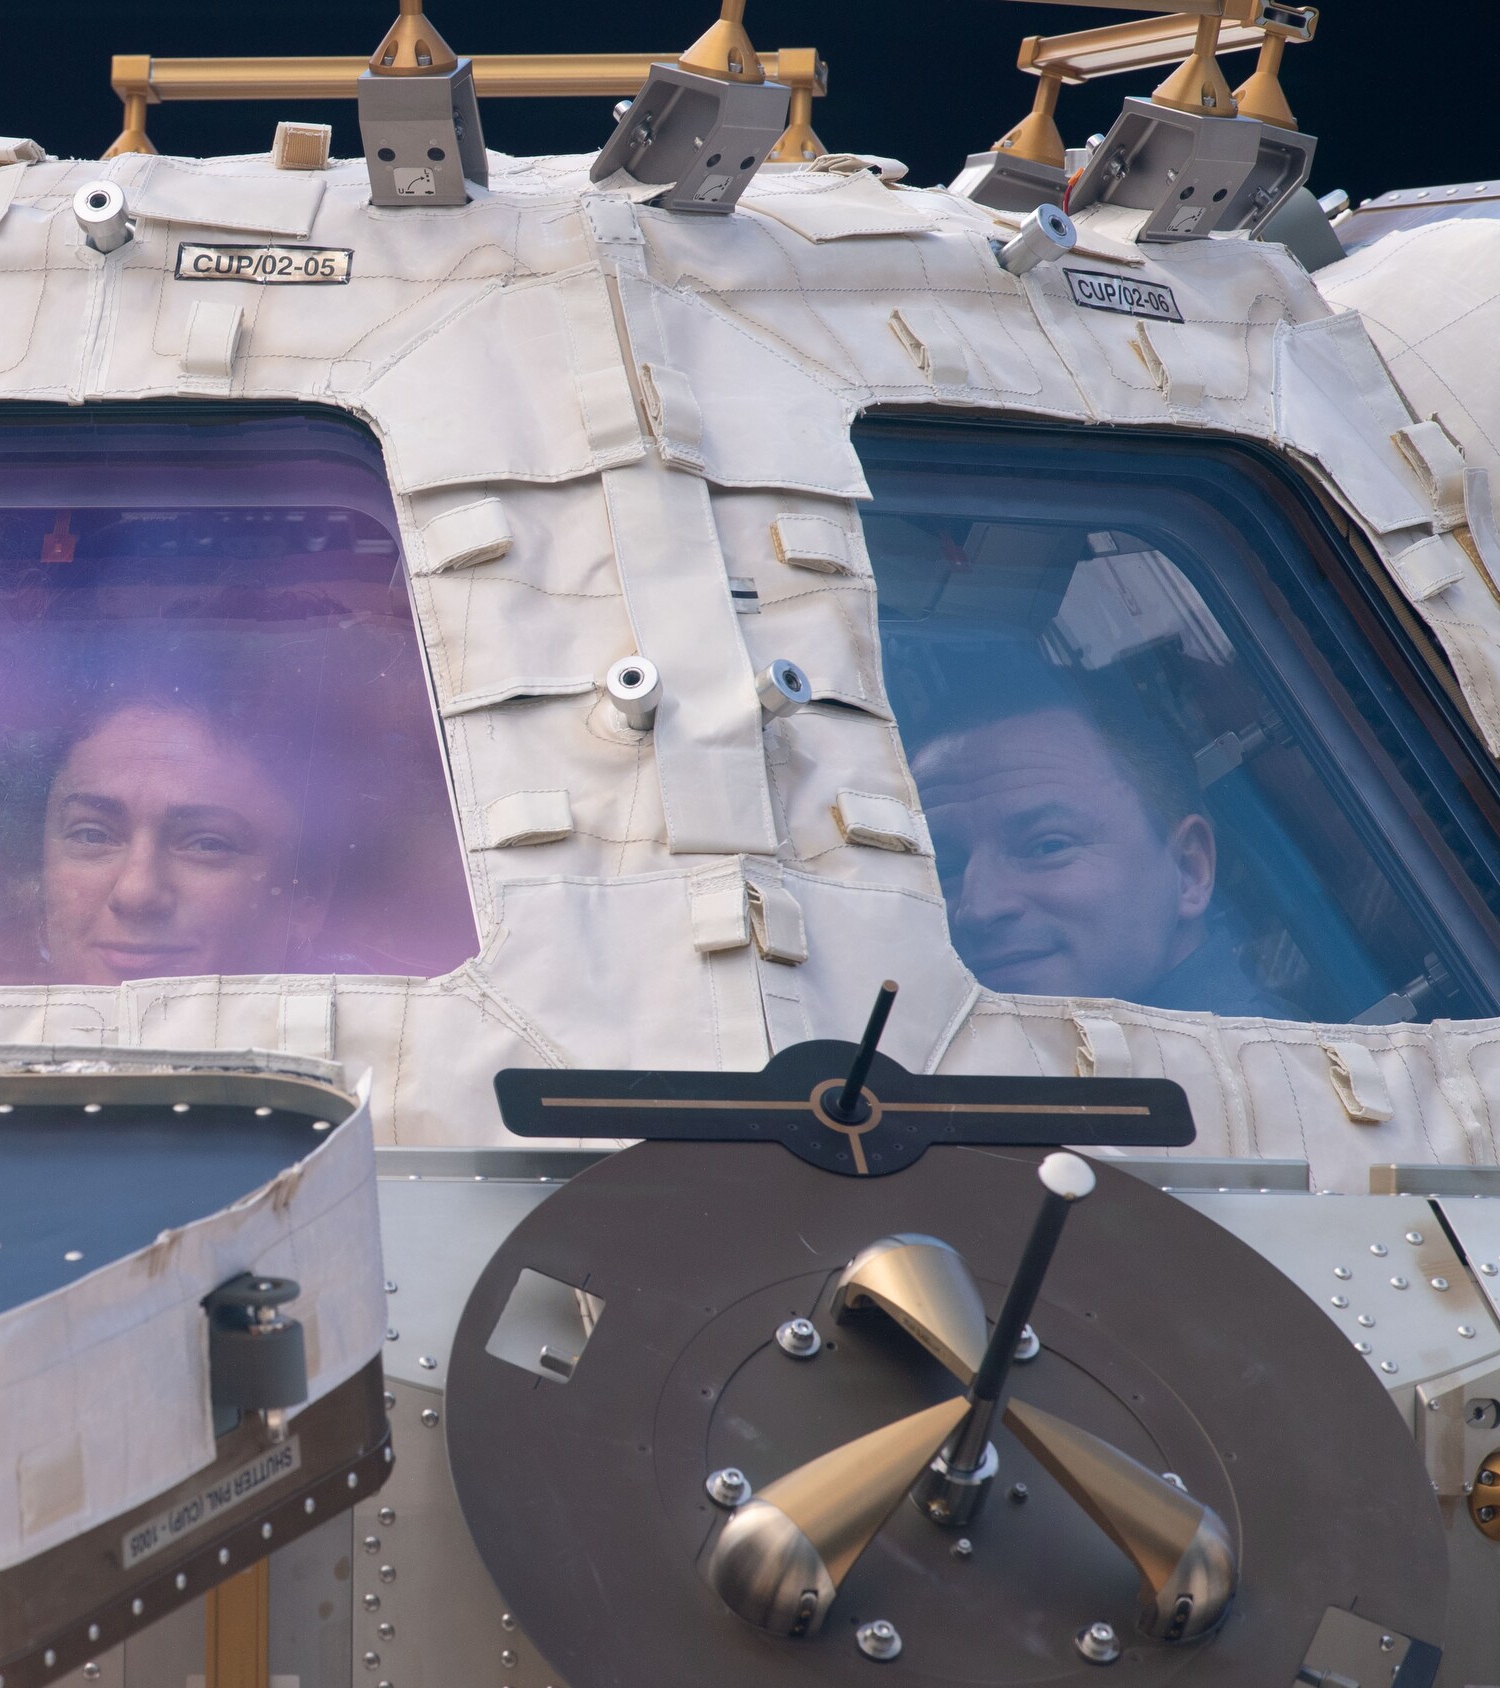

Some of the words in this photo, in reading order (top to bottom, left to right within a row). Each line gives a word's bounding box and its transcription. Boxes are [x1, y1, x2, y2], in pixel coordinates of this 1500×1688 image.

[193, 254, 336, 277] CUP/02-05
[1078, 279, 1170, 313] CUP/02-06
[234, 1446, 293, 1497] SHUTTER
[205, 1484, 233, 1509] PNL
[167, 1498, 205, 1535] (CUP)
